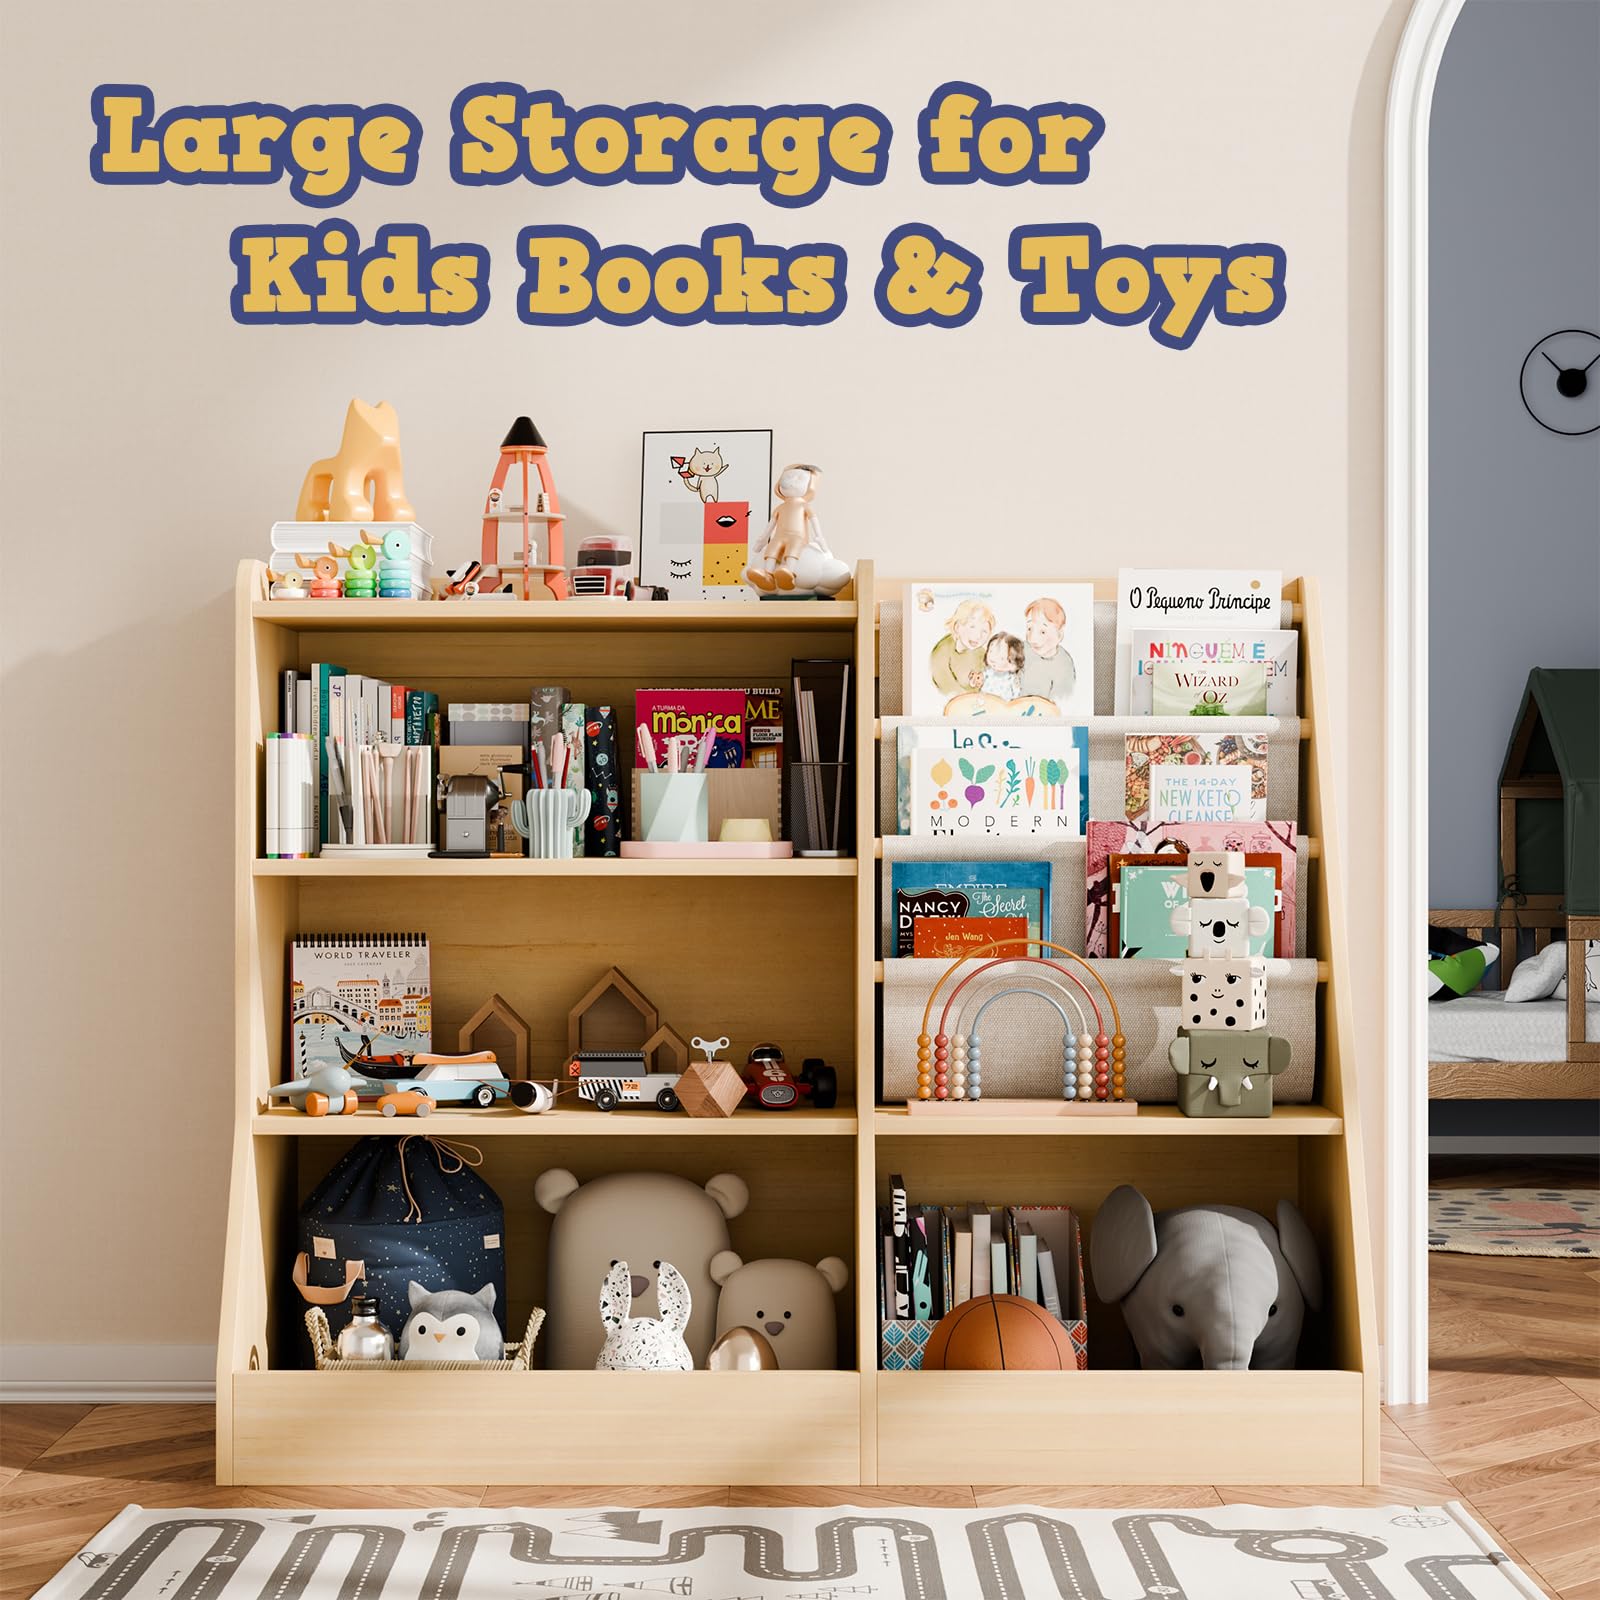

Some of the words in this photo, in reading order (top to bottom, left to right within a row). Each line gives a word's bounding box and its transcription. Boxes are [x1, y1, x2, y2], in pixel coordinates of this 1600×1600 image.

[1129, 586, 1142, 609] O
[1146, 586, 1205, 615] Pequeno
[1149, 638, 1246, 660] NINGUÉM
[1174, 672, 1240, 688] WIZARD
[744, 699, 781, 720] ME
[1165, 778, 1189, 786] THE
[1194, 778, 1237, 786] 14-DAY
[1159, 789, 1192, 807] NEW
[1197, 789, 1242, 807] KETO
[1168, 809, 1233, 822] CLEANSE
[972, 892, 992, 905] The
[899, 901, 961, 913] NANCY
[979, 895, 1028, 917] Secret
[945, 933, 960, 941] Jen
[962, 933, 984, 942] Wang
[359, 950, 411, 958] TRAVELER
